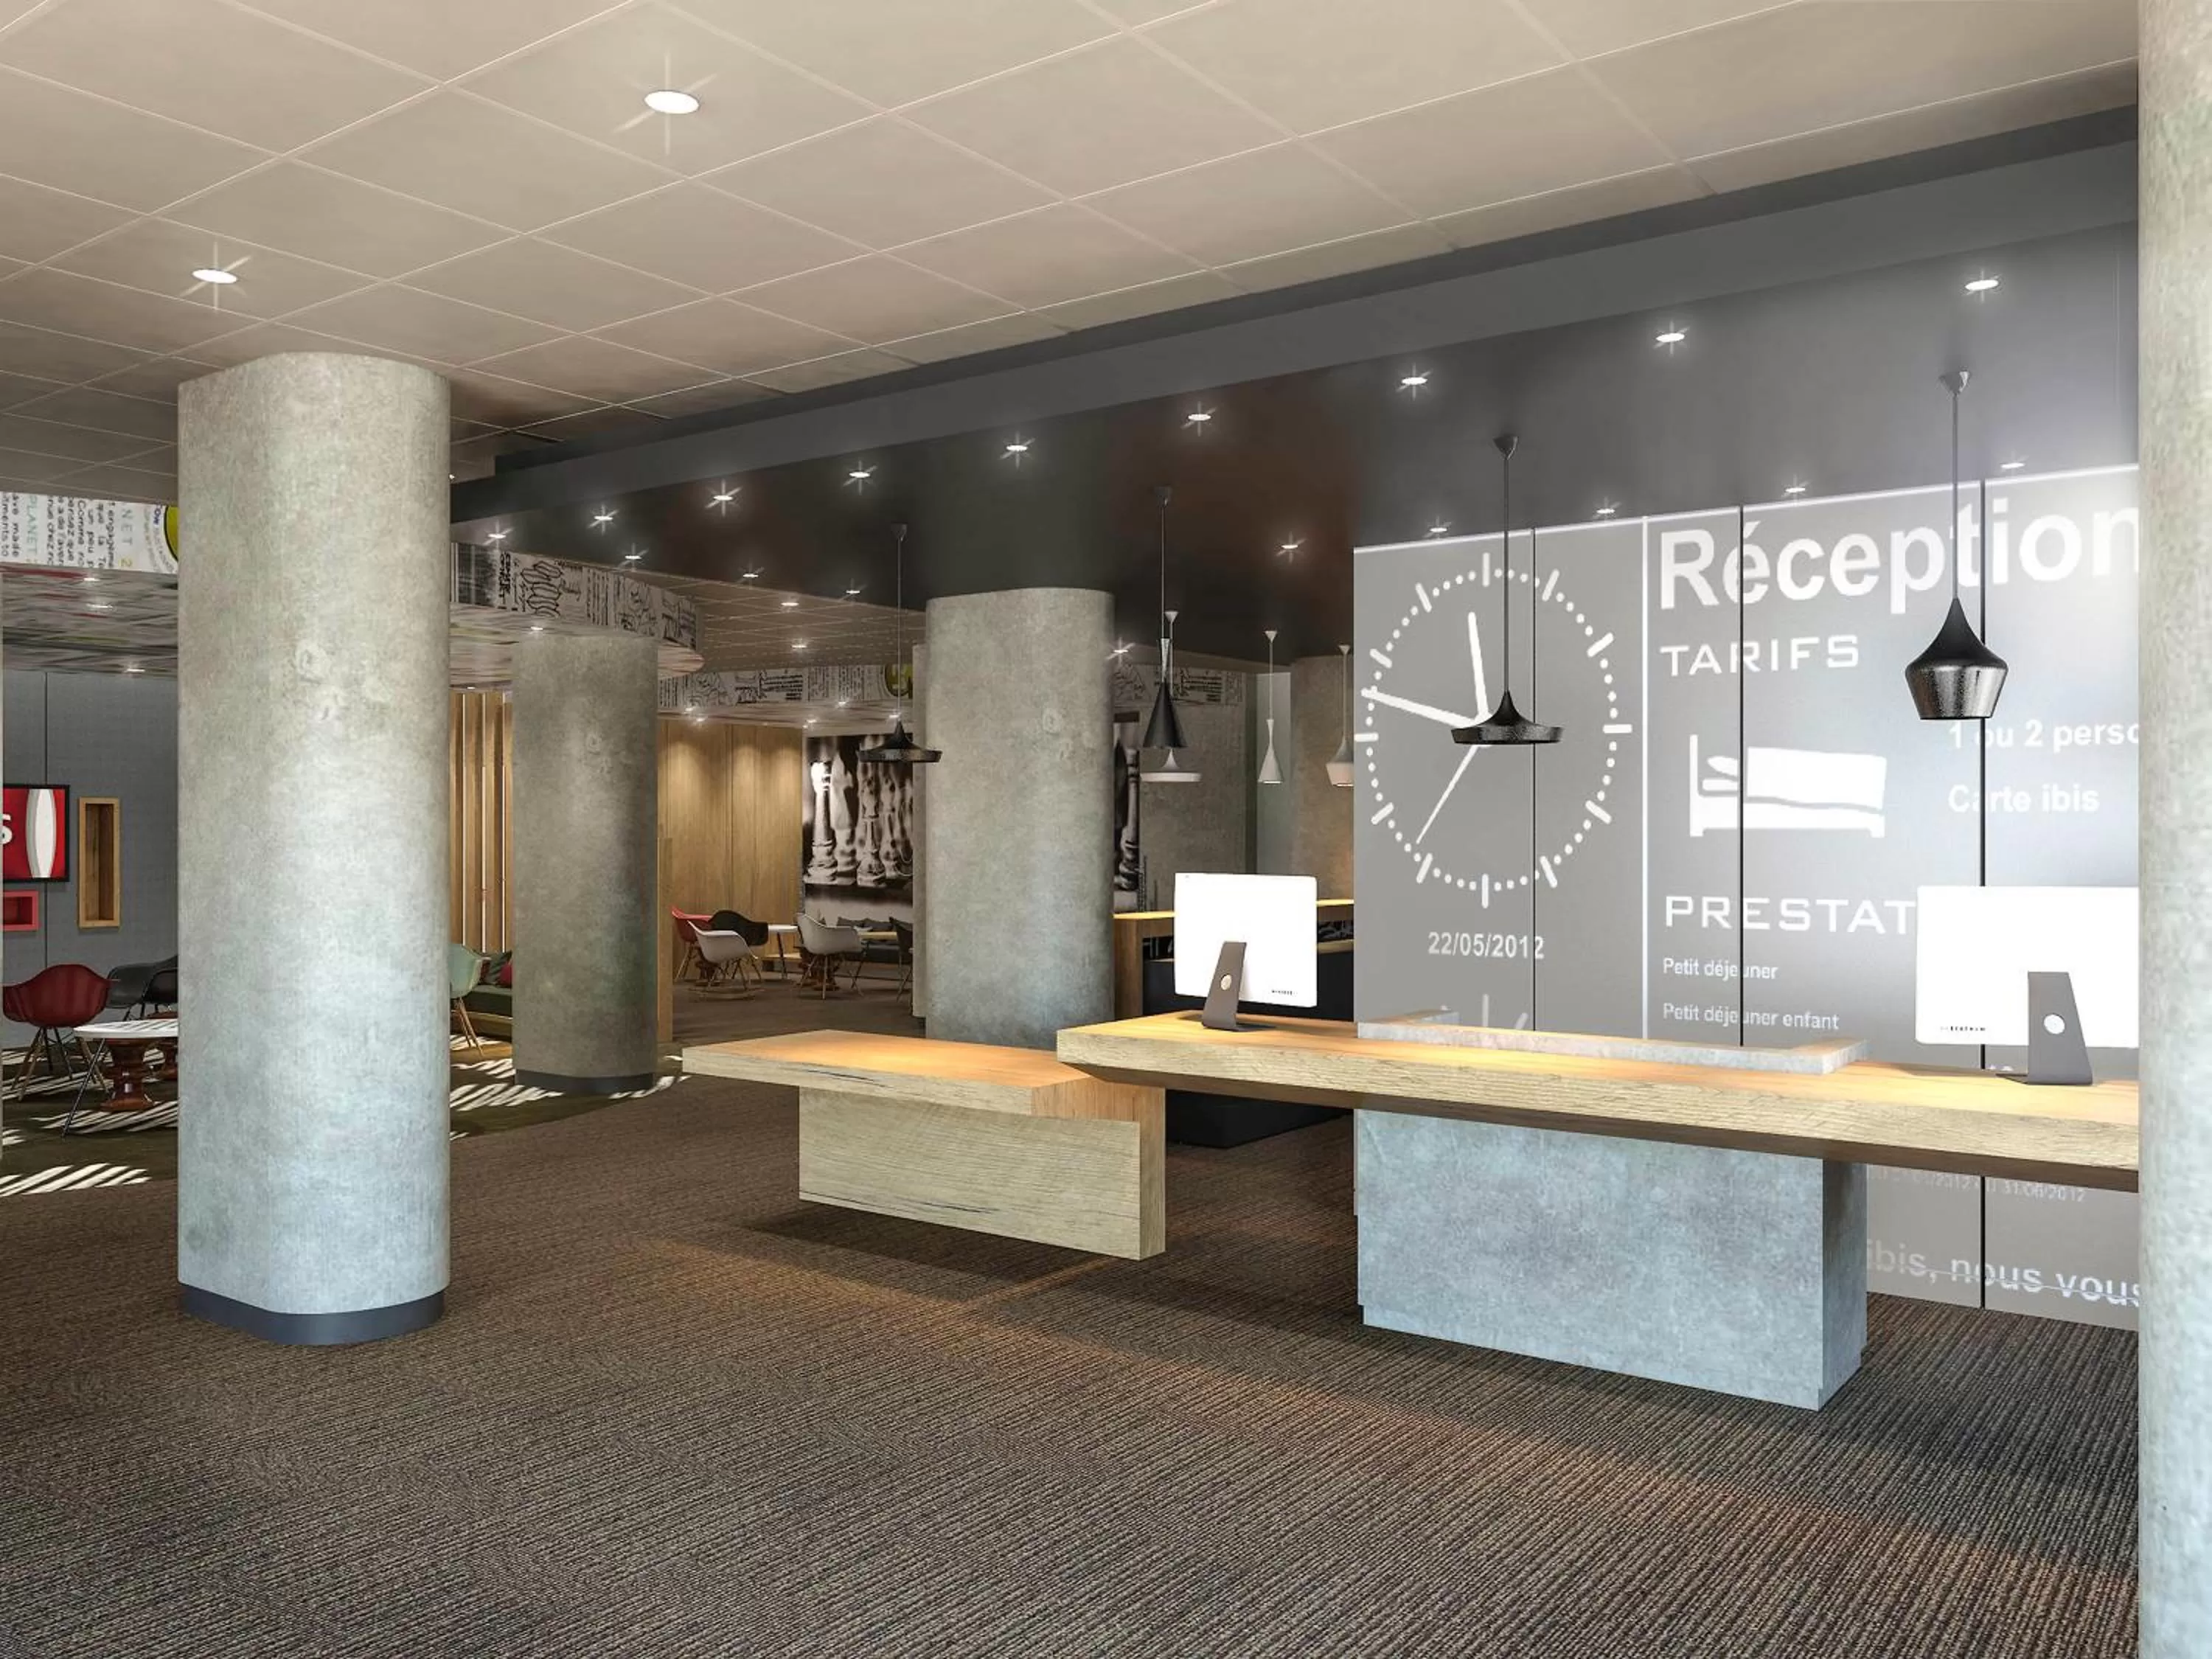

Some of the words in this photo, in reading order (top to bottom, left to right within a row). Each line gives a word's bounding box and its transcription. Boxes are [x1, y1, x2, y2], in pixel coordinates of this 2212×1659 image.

[1659, 496, 2139, 615] Réception
[1659, 634, 1860, 678] TARIFS
[1950, 721, 1963, 749] 1
[2025, 719, 2043, 746] 2
[2042, 784, 2100, 813] ibis
[1665, 895, 1917, 935] PRESTAT
[1427, 931, 1545, 959] 22/05/2012
[1663, 958, 1700, 975] Petit
[1663, 1003, 1700, 1020] Petit
[1782, 1011, 1840, 1030] enfant
[1951, 1258, 2042, 1293] nous
